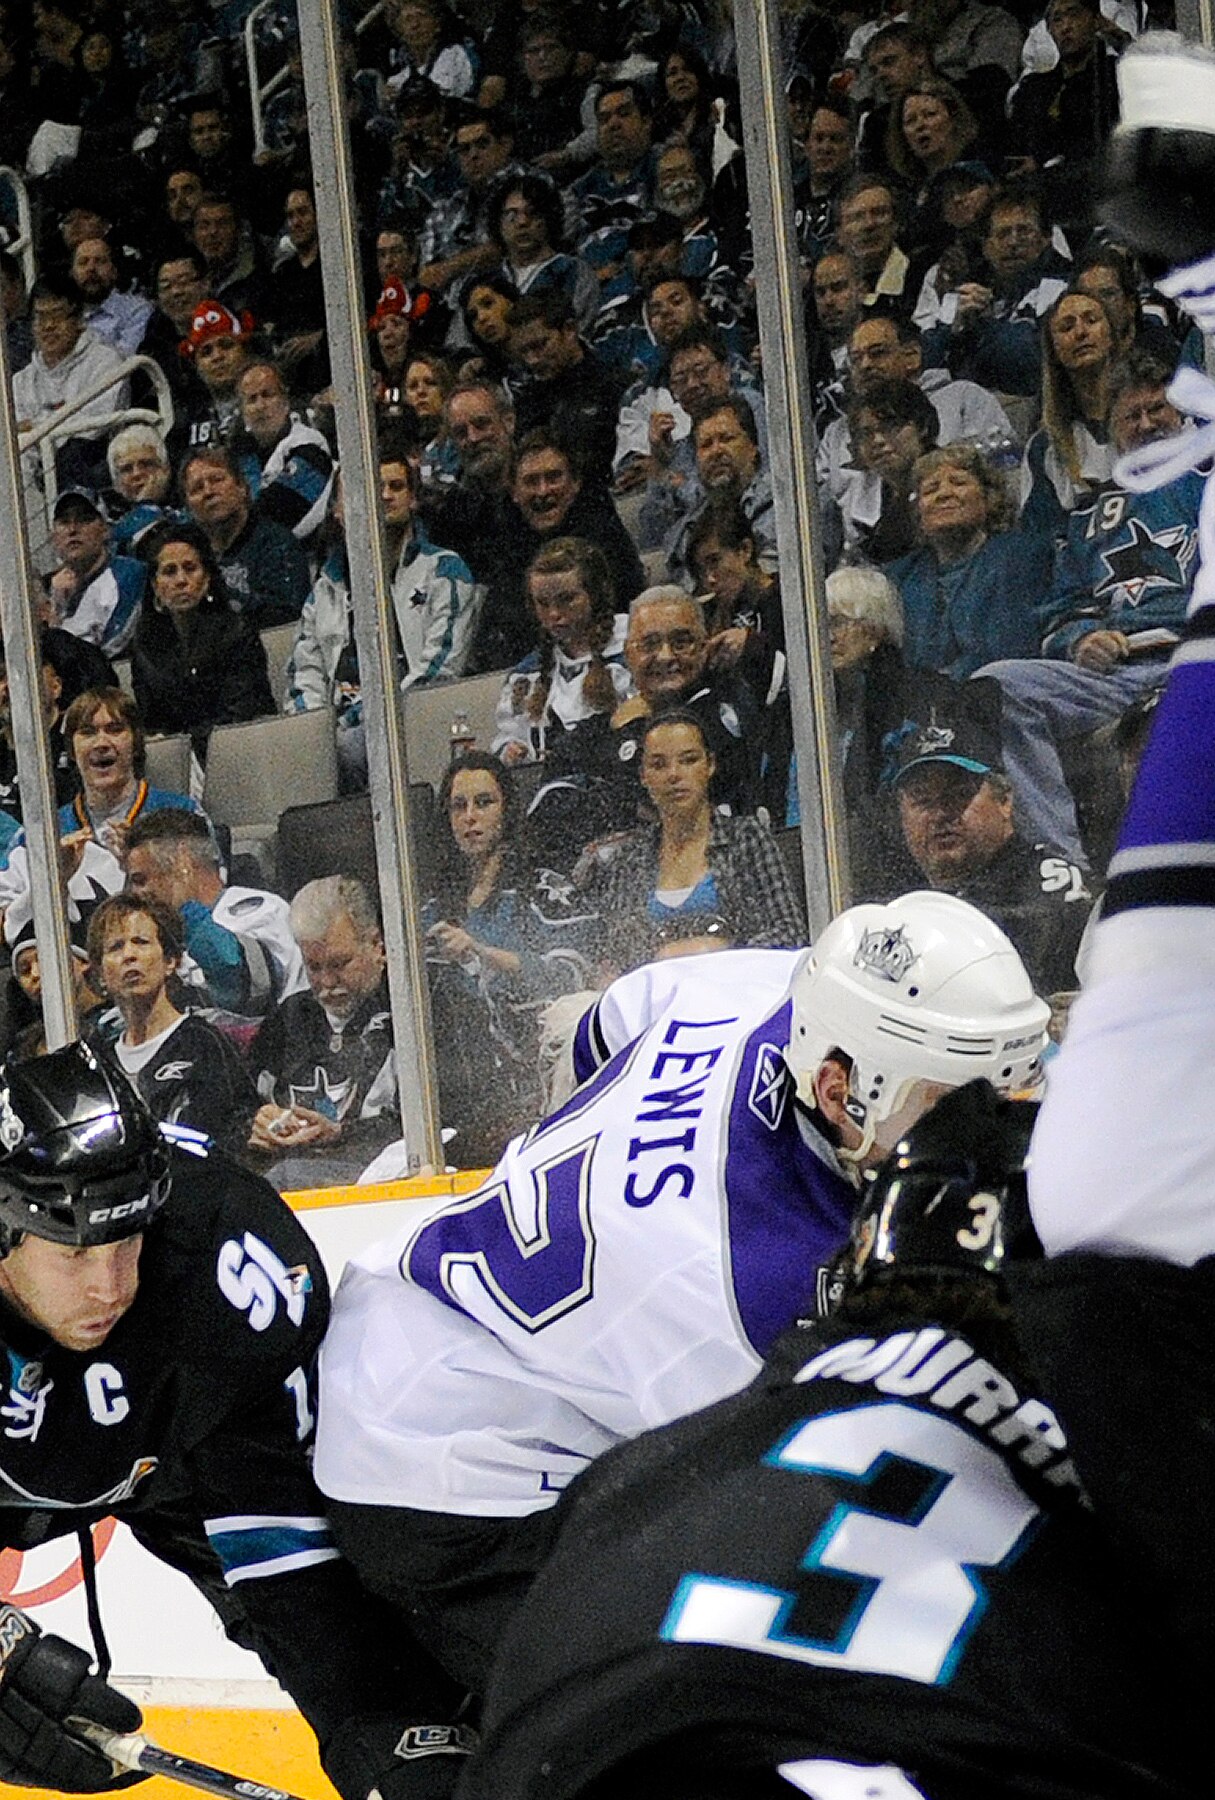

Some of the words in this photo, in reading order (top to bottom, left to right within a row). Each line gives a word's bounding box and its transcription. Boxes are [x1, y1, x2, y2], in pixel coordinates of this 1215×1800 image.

[624, 1017, 739, 1208] LEWIS
[956, 1192, 1001, 1251] 3
[84, 1362, 130, 1426] C
[660, 1400, 1047, 1687] 3
